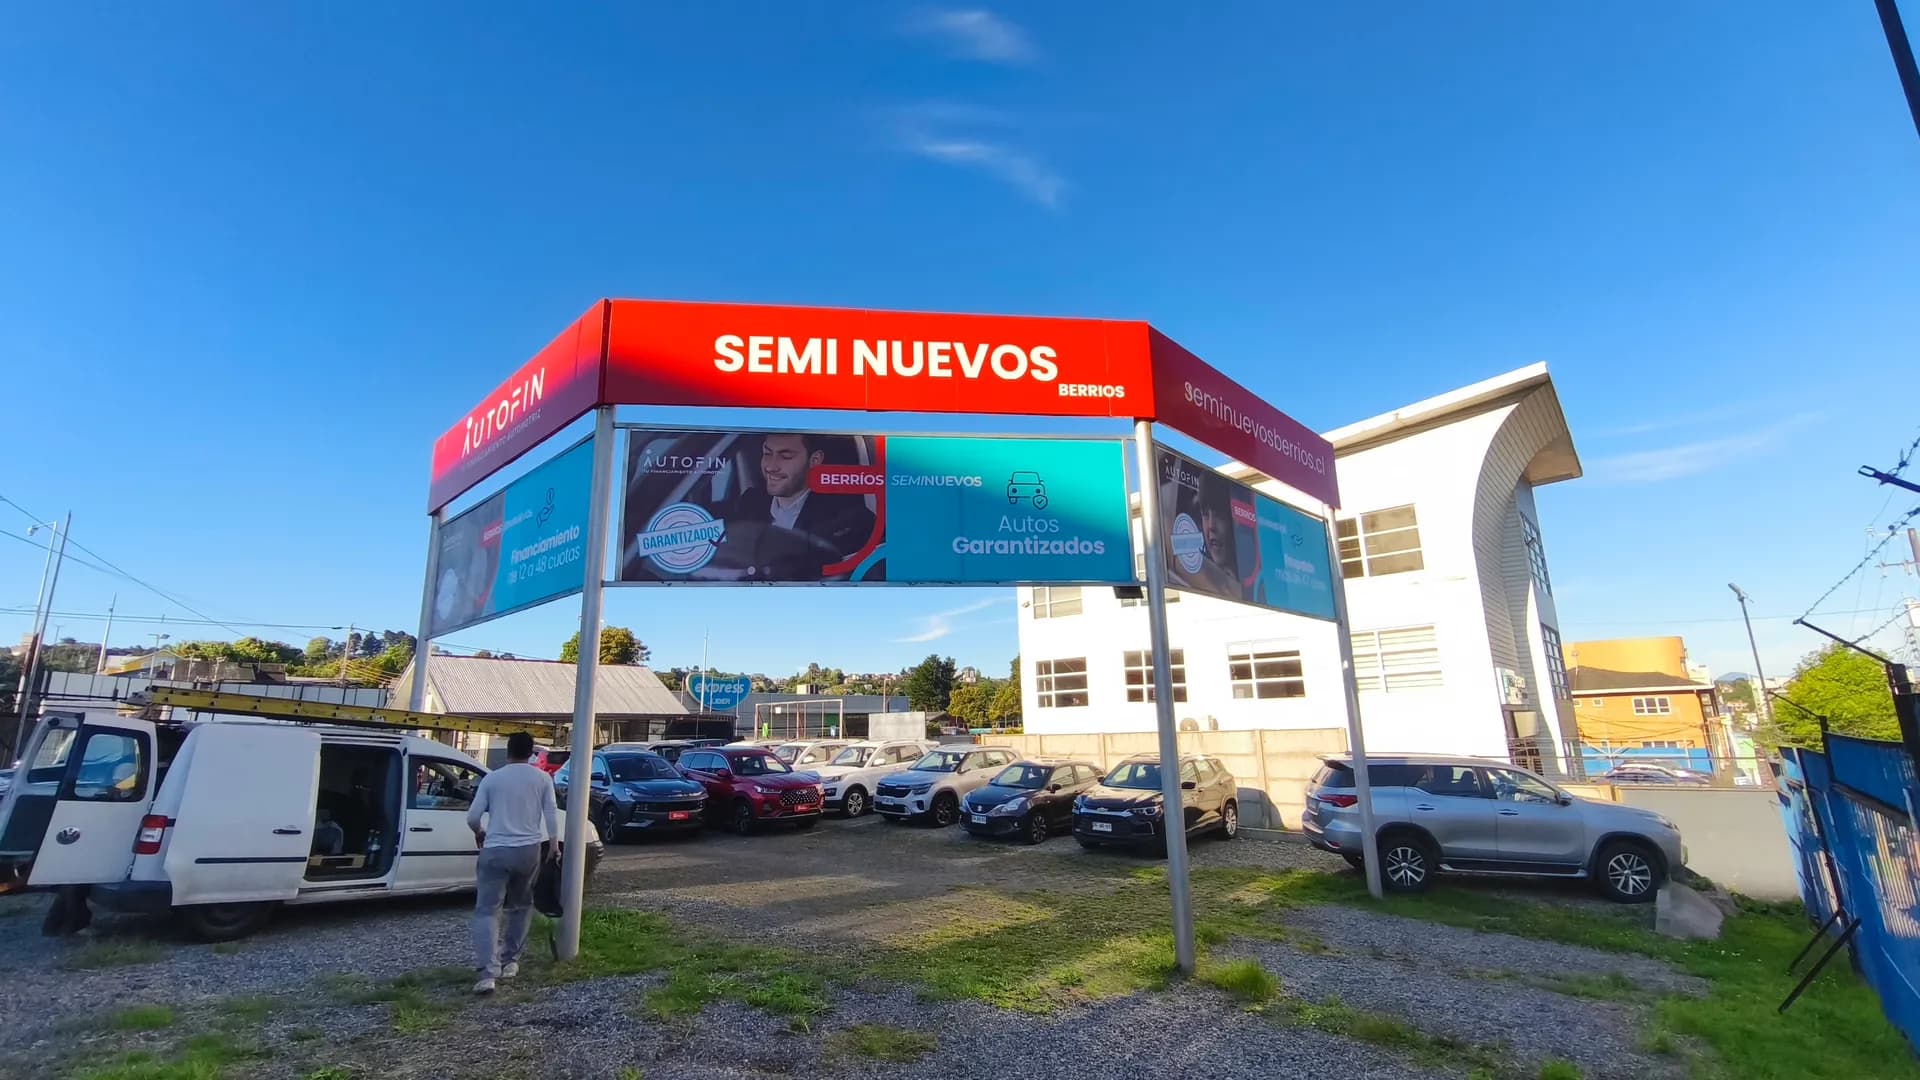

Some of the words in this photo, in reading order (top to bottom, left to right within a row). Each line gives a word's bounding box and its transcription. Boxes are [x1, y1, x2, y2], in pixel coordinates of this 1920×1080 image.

[713, 334, 838, 375] SEMI
[852, 338, 1059, 382] NUEVOS
[1058, 383, 1125, 398] BERRIOS
[461, 367, 546, 459] AUTOFIN
[1184, 381, 1326, 476] seminuevosberrios.cl
[643, 449, 727, 469] AUTOFIN
[820, 472, 885, 486] BERRÍOS
[891, 475, 982, 487] SEMINUEVOS
[1165, 458, 1200, 489] AUTOFIN
[998, 515, 1060, 533] Autos
[511, 524, 580, 564] Financiamiento
[642, 526, 721, 550] GARANTIZADOS
[952, 535, 1105, 555] Garantizados
[519, 562, 527, 580] 12
[527, 565, 534, 578] a
[536, 555, 547, 573] 48
[547, 545, 580, 570] cuotas
[694, 682, 745, 694] express
